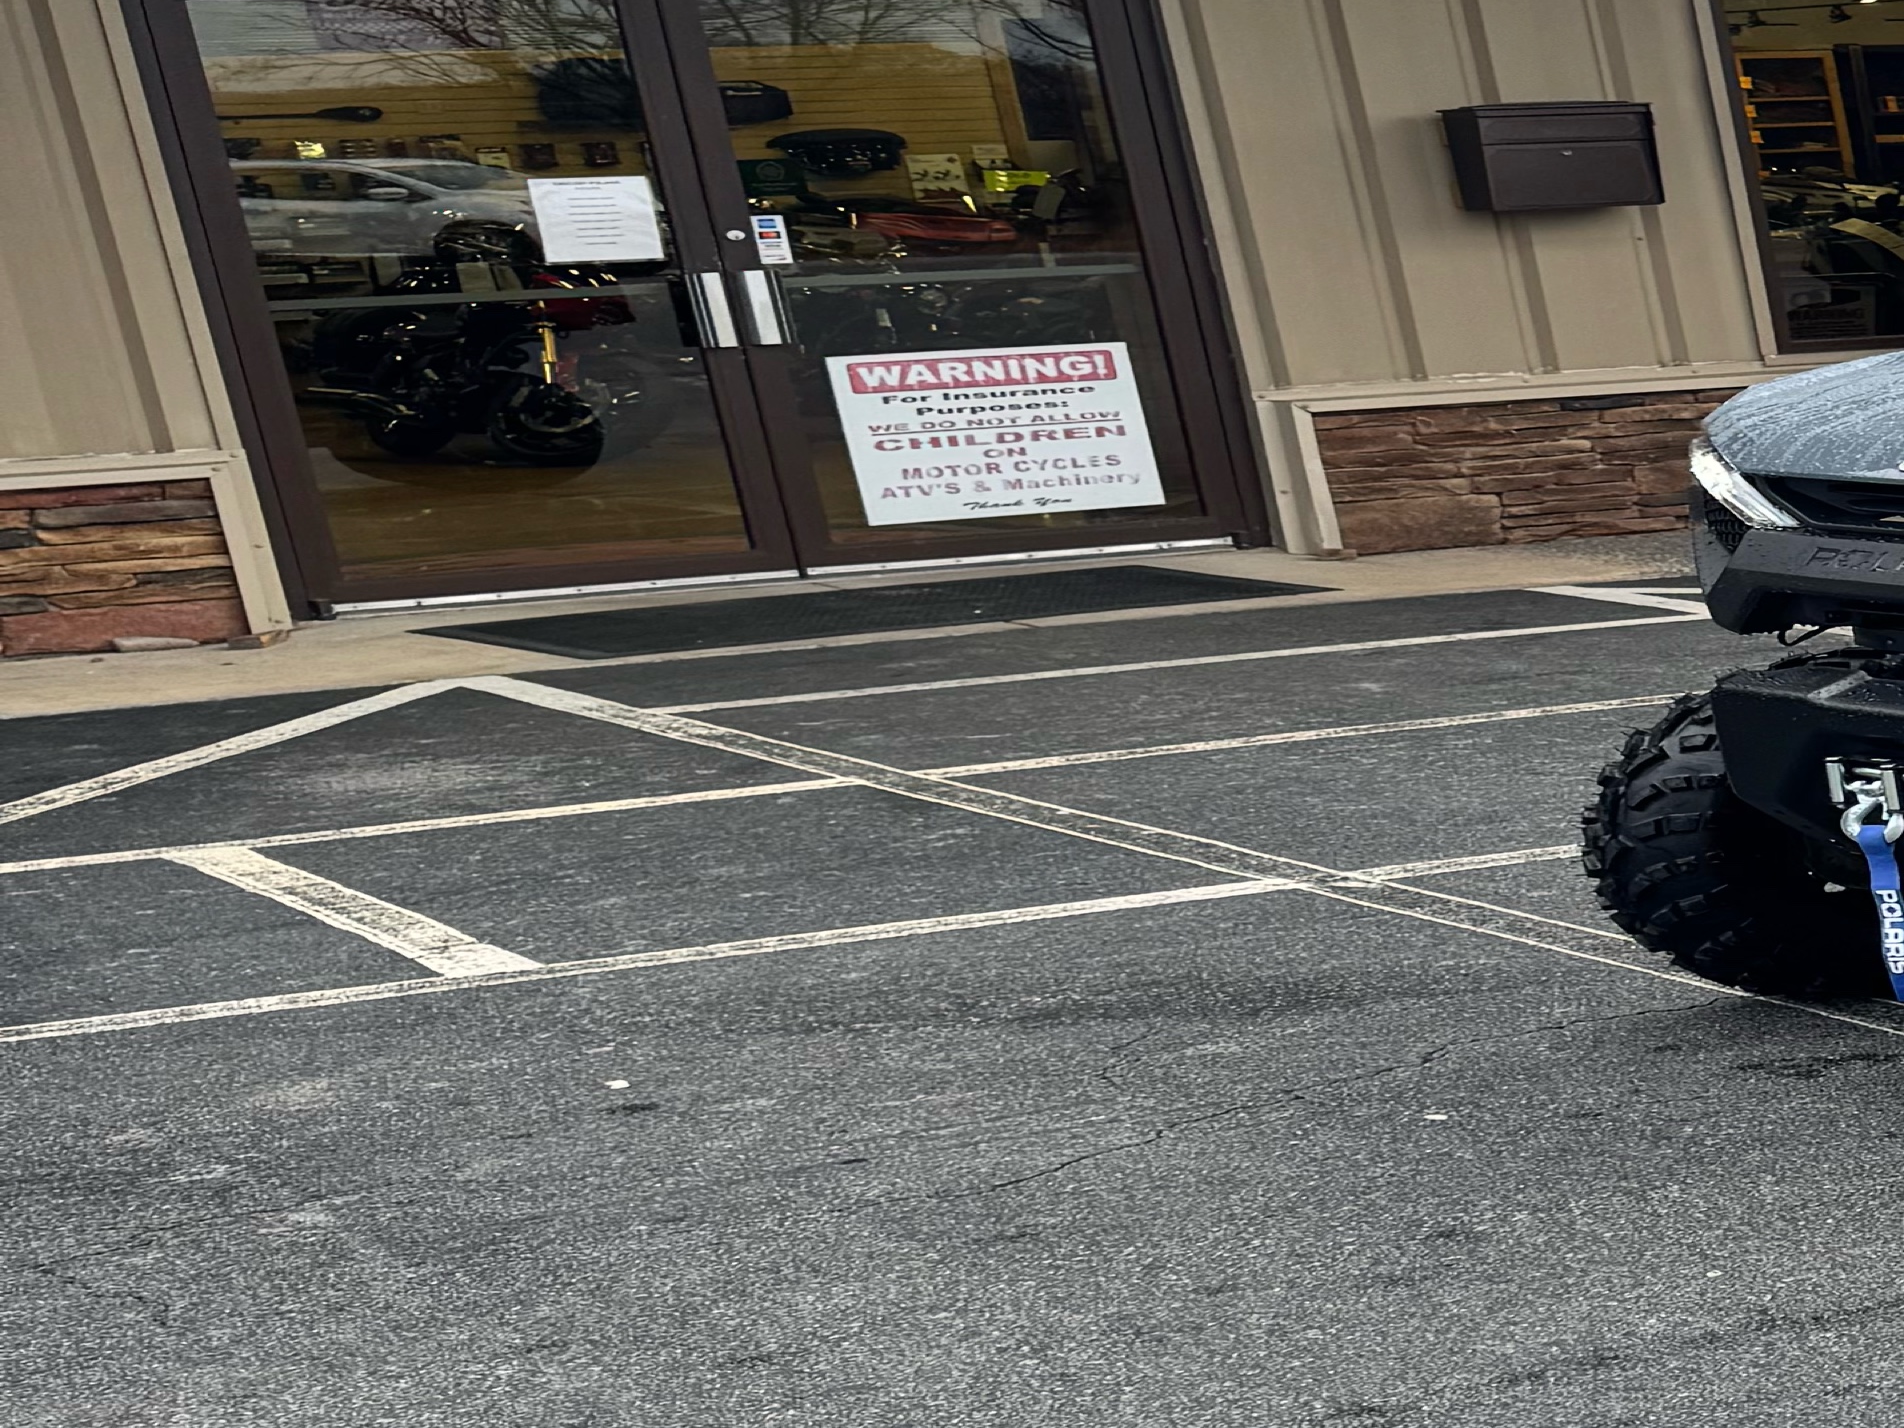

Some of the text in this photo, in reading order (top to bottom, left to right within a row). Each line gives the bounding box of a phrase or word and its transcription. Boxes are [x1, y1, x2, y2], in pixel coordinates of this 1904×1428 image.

[856, 353, 1108, 389] WARNING!
[881, 386, 1096, 405] For Insurance
[916, 400, 1069, 416] Purposes:
[868, 411, 1121, 433] WE DO NOT ALLOW
[873, 424, 1127, 452] CHILDREN
[982, 447, 1028, 459] ON
[902, 454, 1122, 481] MOTOR CYCLES
[881, 473, 1141, 500] ATV'S & Machinery
[963, 497, 1073, 511] Thank You
